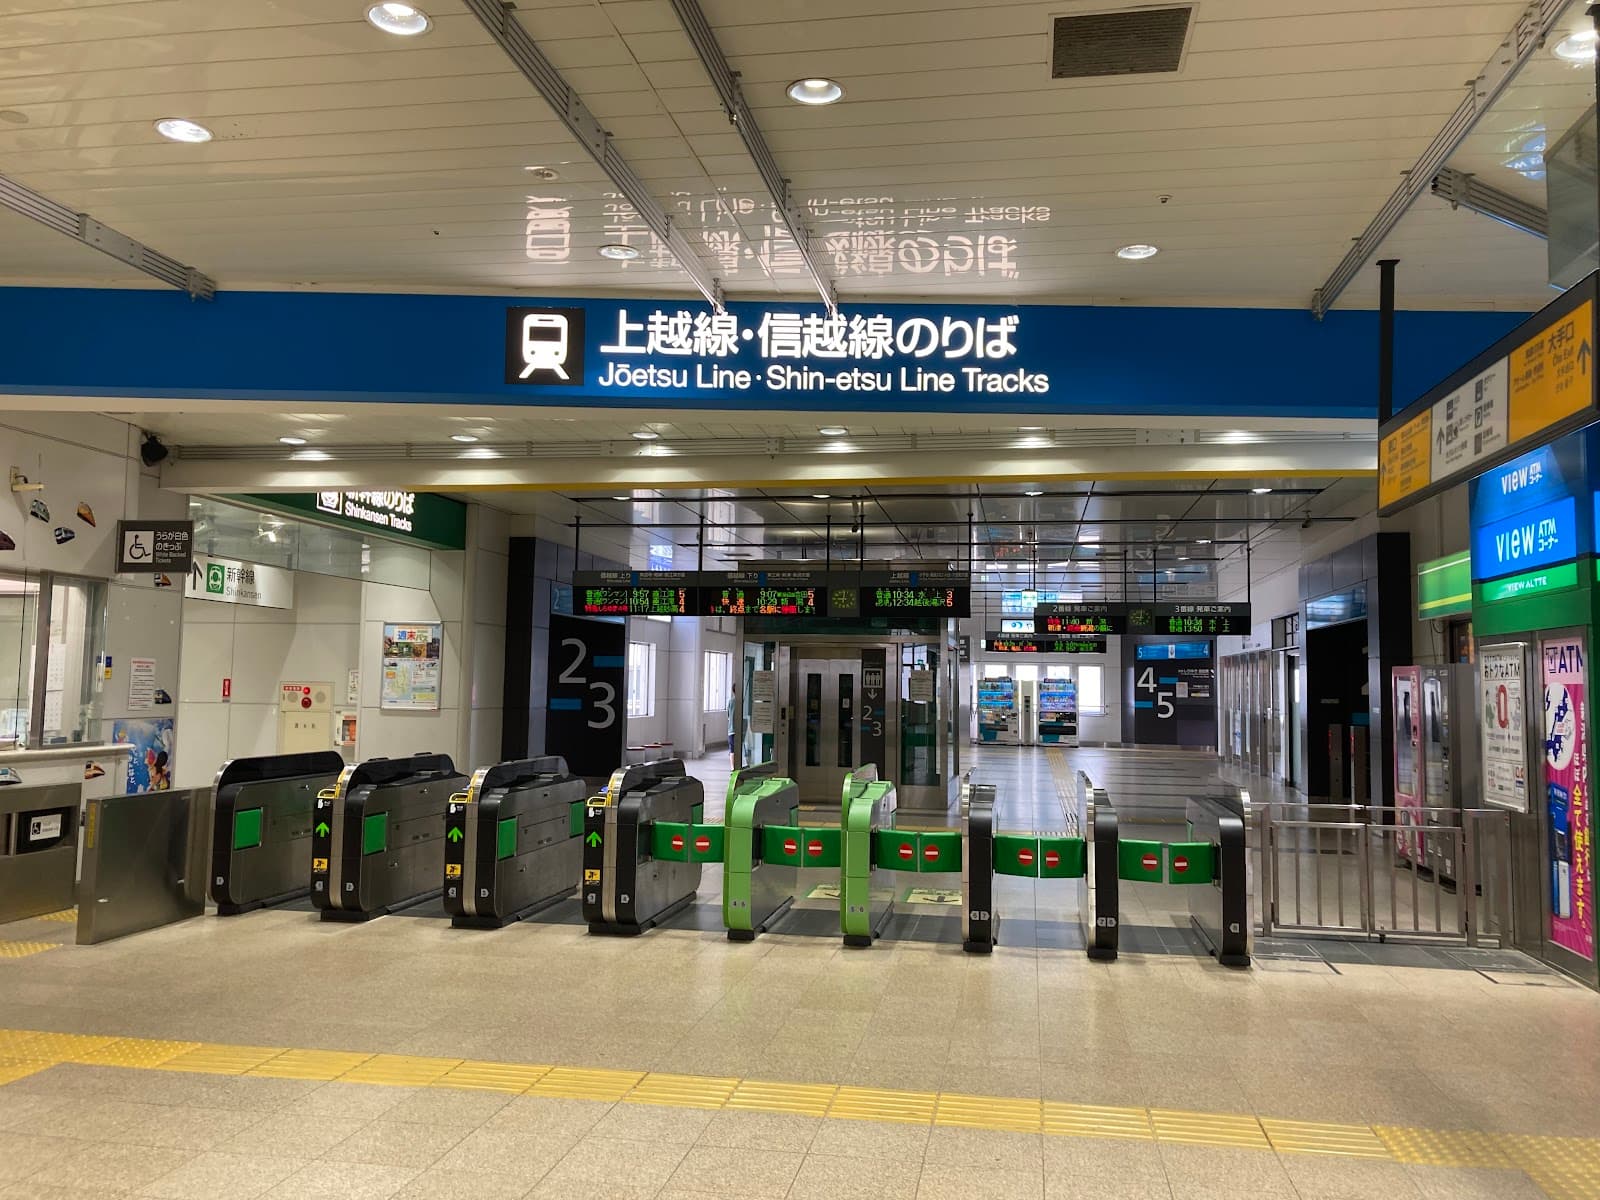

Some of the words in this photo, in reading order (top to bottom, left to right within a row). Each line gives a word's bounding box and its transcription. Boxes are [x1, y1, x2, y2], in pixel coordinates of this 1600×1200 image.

[599, 308, 1020, 361] 上越線・信越線のりば
[1548, 321, 1575, 354] 大手口
[598, 362, 688, 389] Jōetsu
[696, 363, 752, 391] Line
[766, 364, 892, 393] Shin-etsu
[900, 366, 956, 393] Line
[962, 368, 1050, 394] Tracks
[345, 501, 389, 526] Shinkansen
[389, 513, 412, 532] Tracks
[1539, 517, 1557, 538] ATM
[155, 531, 189, 541] うらが白色
[227, 567, 255, 584] 新幹線
[226, 587, 262, 600] Shinkansen
[633, 590, 650, 598] 9:57
[679, 590, 686, 598] 5
[760, 590, 777, 598] 9:07
[807, 590, 815, 598] 5
[892, 590, 914, 599] 10:34
[946, 590, 953, 598] 3
[630, 605, 650, 613] 11:17
[679, 605, 686, 613] 4
[807, 598, 815, 606] 4
[892, 598, 914, 607] 12:34
[1175, 605, 1194, 613] 3番線
[1184, 625, 1203, 633] 13:50
[1138, 647, 1143, 658] 5
[1203, 644, 1209, 657] 4
[559, 638, 587, 684] 2
[1137, 666, 1157, 693] 4
[587, 681, 616, 729] 3
[1157, 691, 1174, 718] 5
[863, 705, 872, 721] 2
[872, 721, 882, 737] 3
